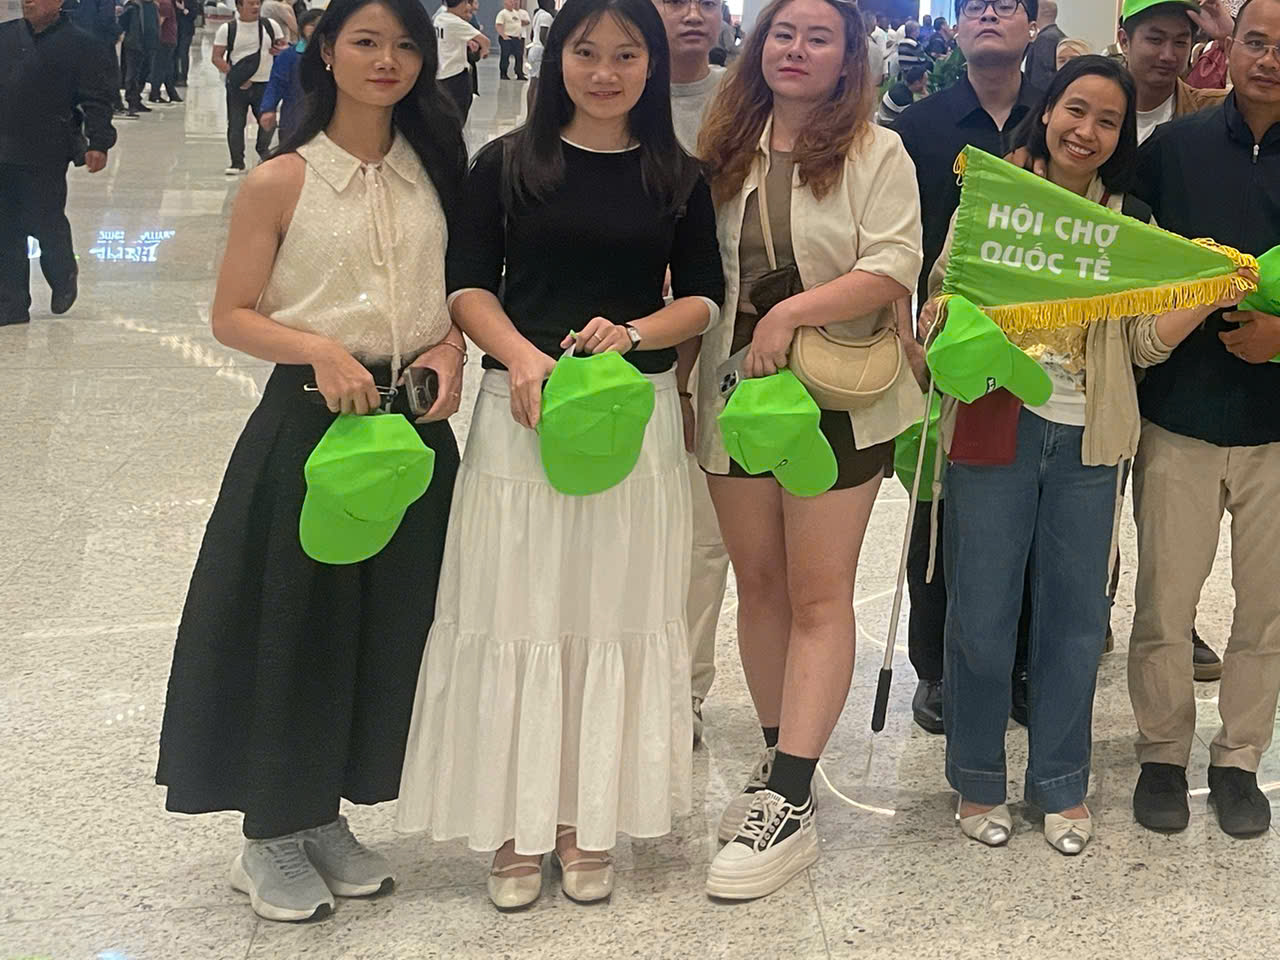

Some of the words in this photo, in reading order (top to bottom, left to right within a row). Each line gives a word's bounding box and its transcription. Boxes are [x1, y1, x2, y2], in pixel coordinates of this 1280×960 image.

[988, 203, 1044, 240] HỘI
[1055, 216, 1120, 252] CHỢ
[980, 240, 1064, 275] QUỐC
[1075, 253, 1112, 282] TẾ
